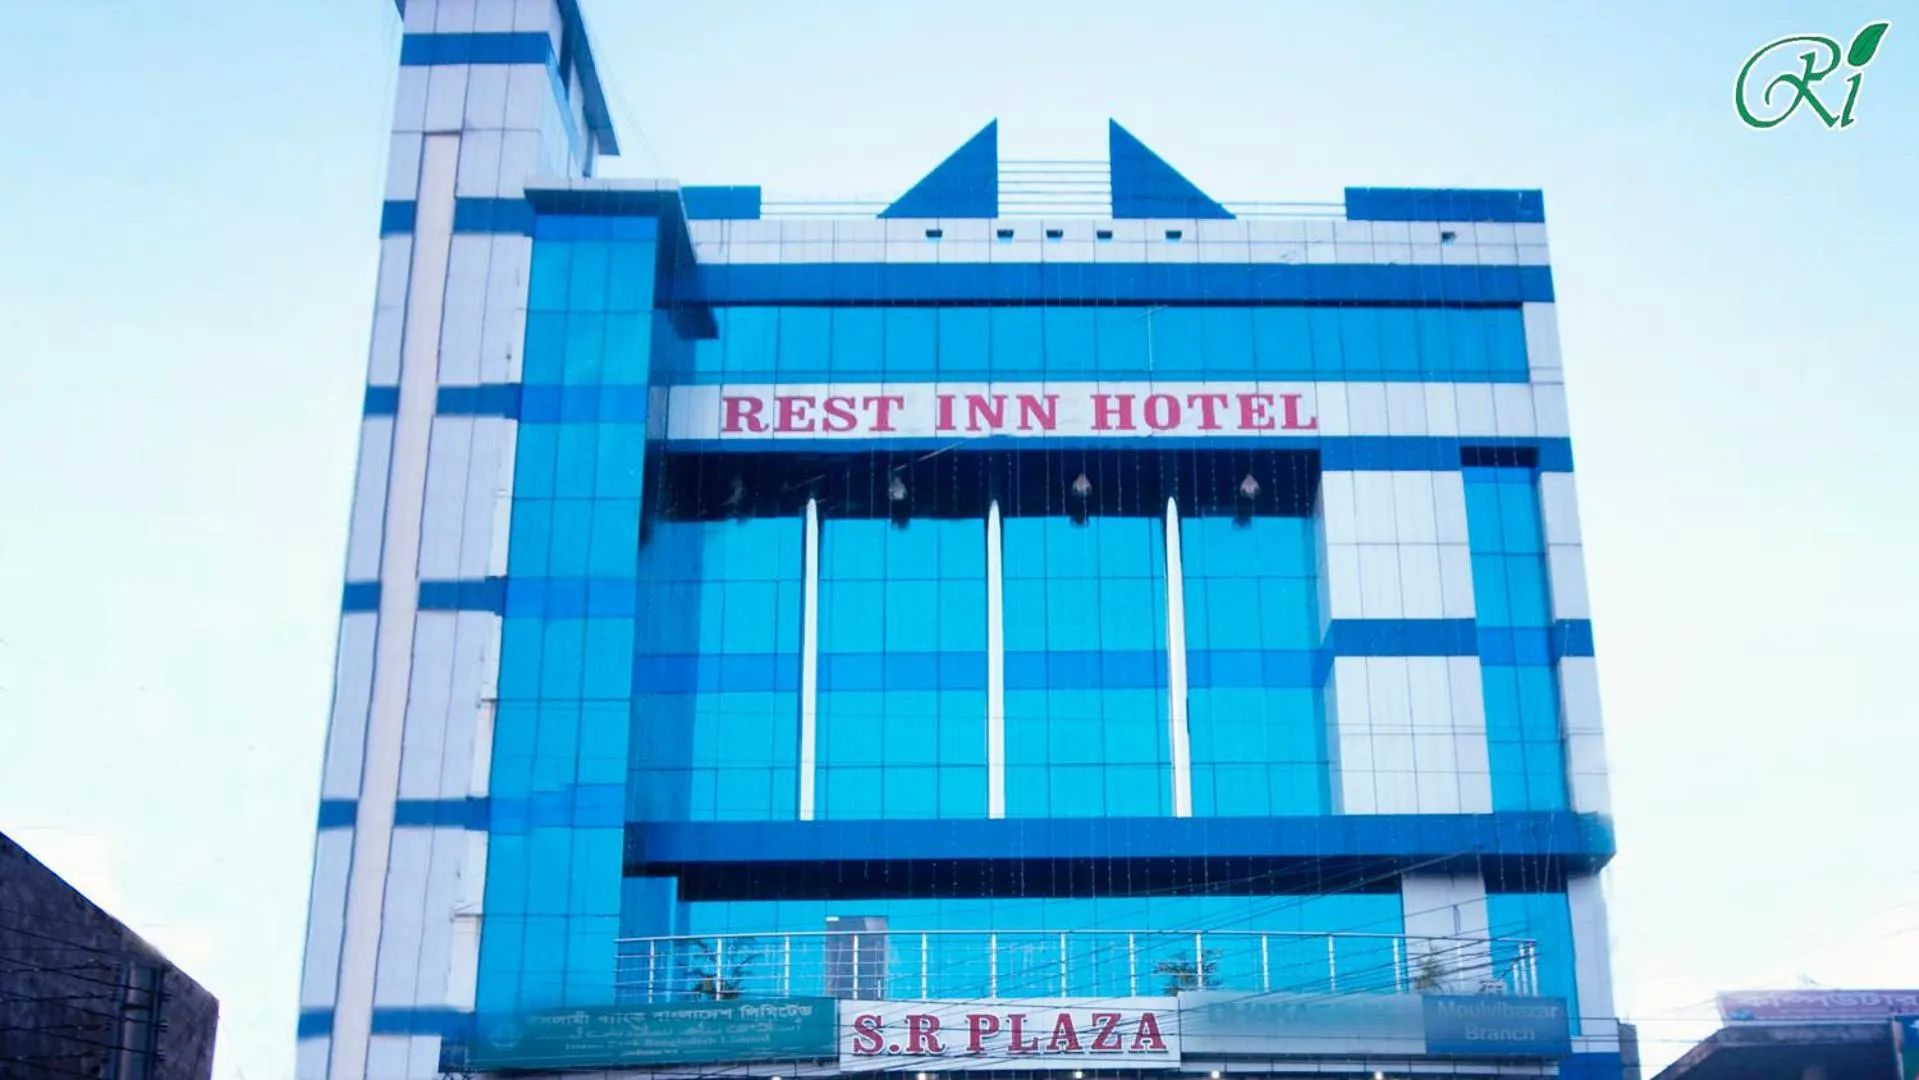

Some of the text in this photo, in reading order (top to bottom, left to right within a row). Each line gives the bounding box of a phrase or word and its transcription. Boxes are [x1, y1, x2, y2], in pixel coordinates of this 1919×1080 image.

[720, 394, 1318, 433] REST INN HOTEL
[1437, 1000, 1559, 1019] Moulvibazar
[852, 1014, 945, 1056] S.R
[965, 1012, 1168, 1055] PLAZA
[1465, 1023, 1536, 1042] Branch
